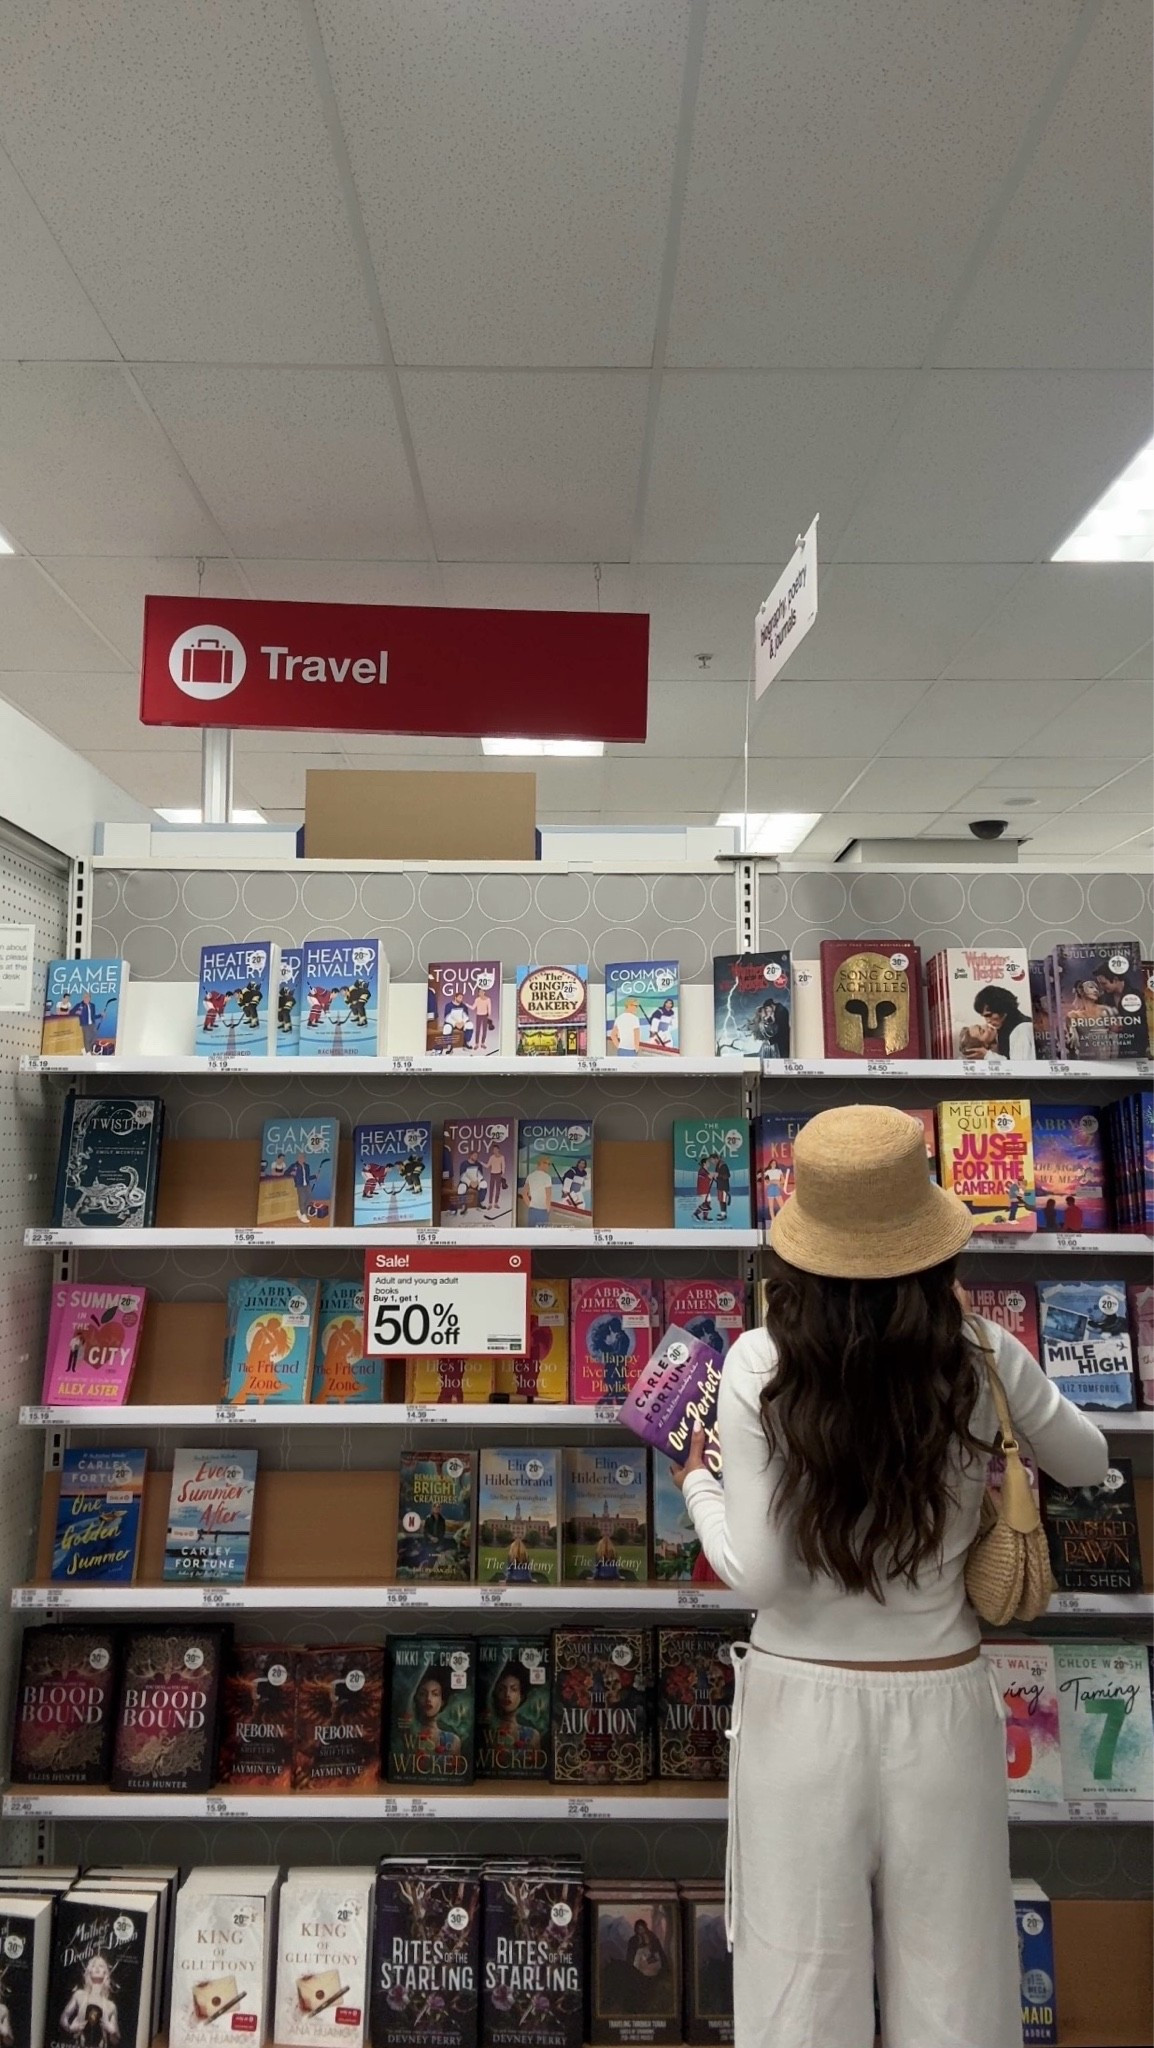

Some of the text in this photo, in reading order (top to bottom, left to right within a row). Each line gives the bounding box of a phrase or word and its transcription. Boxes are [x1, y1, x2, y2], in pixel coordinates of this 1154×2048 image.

[787, 564, 807, 607] poetry
[774, 607, 797, 658] journals
[260, 646, 388, 684] Travel
[1067, 949, 1131, 959] JULIA QUINN
[54, 966, 118, 983] GAME
[203, 966, 264, 983] RIVALRY
[307, 963, 375, 978] RIVALRY
[544, 973, 562, 981] The
[840, 970, 902, 981] SONG OF
[52, 983, 116, 994] CHANGER
[442, 983, 479, 996] GUY
[836, 982, 907, 993] ACHILLES
[528, 1001, 578, 1011] BAKERY
[1071, 1016, 1142, 1027] BRIDGERTON
[950, 1104, 1022, 1117] MEGHAN
[267, 1125, 331, 1143] GAME
[360, 1140, 426, 1156] RIVALRY
[457, 1139, 492, 1154] GUY
[685, 1145, 739, 1158] GAME
[953, 1133, 1023, 1160] JUST
[953, 1161, 1024, 1181] FOR THE
[954, 1181, 1011, 1196] CAMERAS
[376, 1255, 409, 1267] Sale!
[375, 1277, 395, 1285] Adult
[398, 1277, 412, 1285] and
[258, 1287, 295, 1297] ABBY
[594, 1288, 630, 1297] ABBY
[687, 1289, 721, 1299] ABBY
[977, 1291, 996, 1305] HER
[400, 1295, 412, 1303] get
[72, 1323, 89, 1331] THE
[431, 1327, 460, 1345] off
[88, 1347, 130, 1365] CITY
[601, 1352, 640, 1365] Happy
[1048, 1345, 1096, 1361] MILE
[238, 1361, 299, 1373] The Friend
[335, 1361, 376, 1374] Friend
[459, 1360, 482, 1371] Too
[534, 1360, 557, 1372] Too
[582, 1365, 642, 1378] Ever After
[1078, 1357, 1128, 1373] HIGH
[249, 1377, 282, 1390] Zone
[328, 1378, 360, 1391] Zone
[436, 1375, 472, 1389] Short
[513, 1375, 548, 1389] Short
[592, 1381, 631, 1393] Playlist
[634, 1352, 671, 1409] CARLEY
[58, 1384, 119, 1396] ALEX ASTER
[645, 1356, 693, 1424] FORTUNE
[1062, 1384, 1120, 1393] LIZ TOMFORDE
[668, 1358, 723, 1451] Our Perfect
[78, 1460, 129, 1470] CARLEY
[595, 1458, 618, 1469] Elin
[485, 1474, 553, 1487] Hilderbrand
[177, 1480, 247, 1503] Summer
[413, 1481, 457, 1494] BRIGHT
[71, 1494, 101, 1515] One
[413, 1495, 457, 1504] CREATURES
[200, 1501, 241, 1532] After
[62, 1521, 122, 1550] Golden
[181, 1547, 231, 1556] CARLEY
[67, 1550, 130, 1575] Summer
[175, 1558, 235, 1569] FORTUNE
[485, 1557, 553, 1573] The Academy
[573, 1555, 641, 1571] The Academy
[1065, 1575, 1131, 1587] L.J. SHEN
[395, 1651, 437, 1666] NIKKI ST.
[502, 1648, 516, 1661] ST.
[1058, 1658, 1097, 1668] CHLOE
[24, 1686, 105, 1705] BLOOD
[125, 1689, 207, 1710] BLOOD
[1059, 1676, 1141, 1715] Taming
[22, 1705, 103, 1724] BOUND
[123, 1709, 205, 1729] BOUND
[560, 1707, 637, 1735] AUCTION
[236, 1722, 284, 1743] REBORN
[314, 1725, 364, 1745] REBORN
[1084, 1698, 1125, 1780] 7
[393, 1753, 468, 1775] WICKED
[475, 1749, 548, 1769] WICKED
[232, 1765, 283, 1775] JAYMIN EVE
[311, 1766, 363, 1778] JAYMIN EVE
[52, 1773, 87, 1781] HUNTER
[128, 1780, 188, 1789] ELLIS HUNTER
[301, 1923, 347, 1937] KING
[197, 1930, 243, 1944] KING
[213, 1948, 226, 1956] OF
[393, 1937, 468, 1964] RITES THE
[497, 1936, 573, 1965] RITES THE
[285, 1953, 360, 1966] GLUTTONY
[181, 1961, 256, 1972] GLUTTONY
[381, 1962, 473, 1991] STARLING
[486, 1962, 578, 1991] STARLING
[388, 2034, 463, 2046] DEVNEY PERRY
[493, 2034, 567, 2046] DEVNEY PERRY
